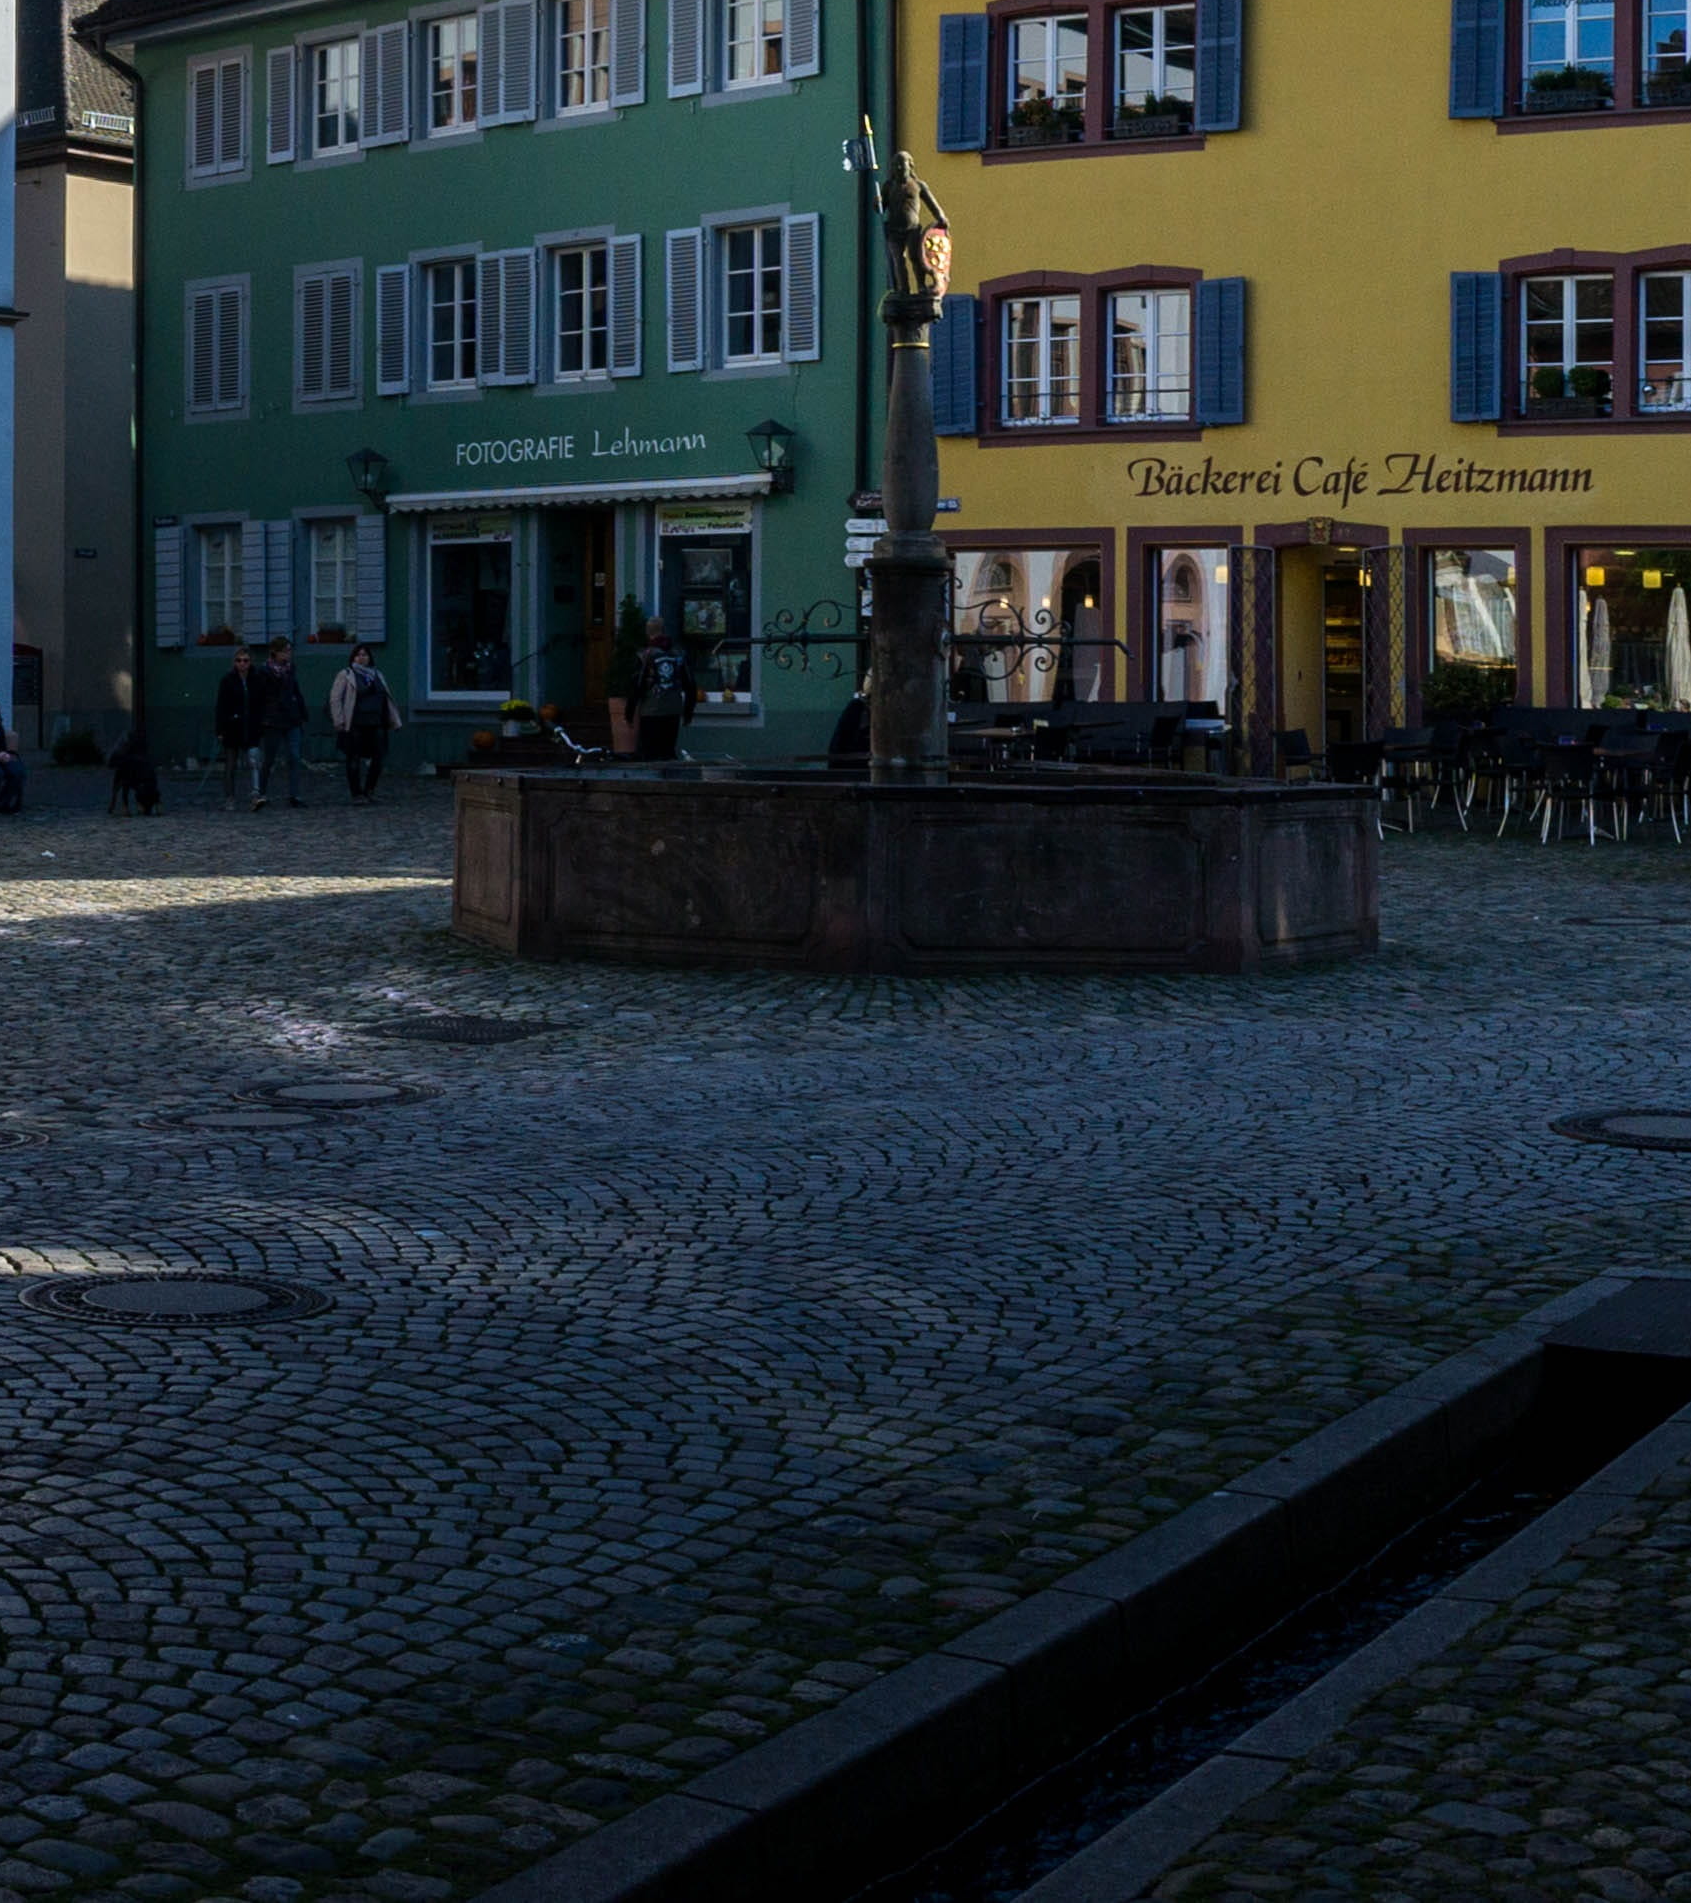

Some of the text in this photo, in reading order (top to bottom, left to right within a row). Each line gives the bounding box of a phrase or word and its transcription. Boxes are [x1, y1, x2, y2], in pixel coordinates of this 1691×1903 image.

[456, 426, 706, 466] FOTOGRAFIE Lehmann
[1127, 453, 1594, 509] Bäckerei Café Heitzmann
